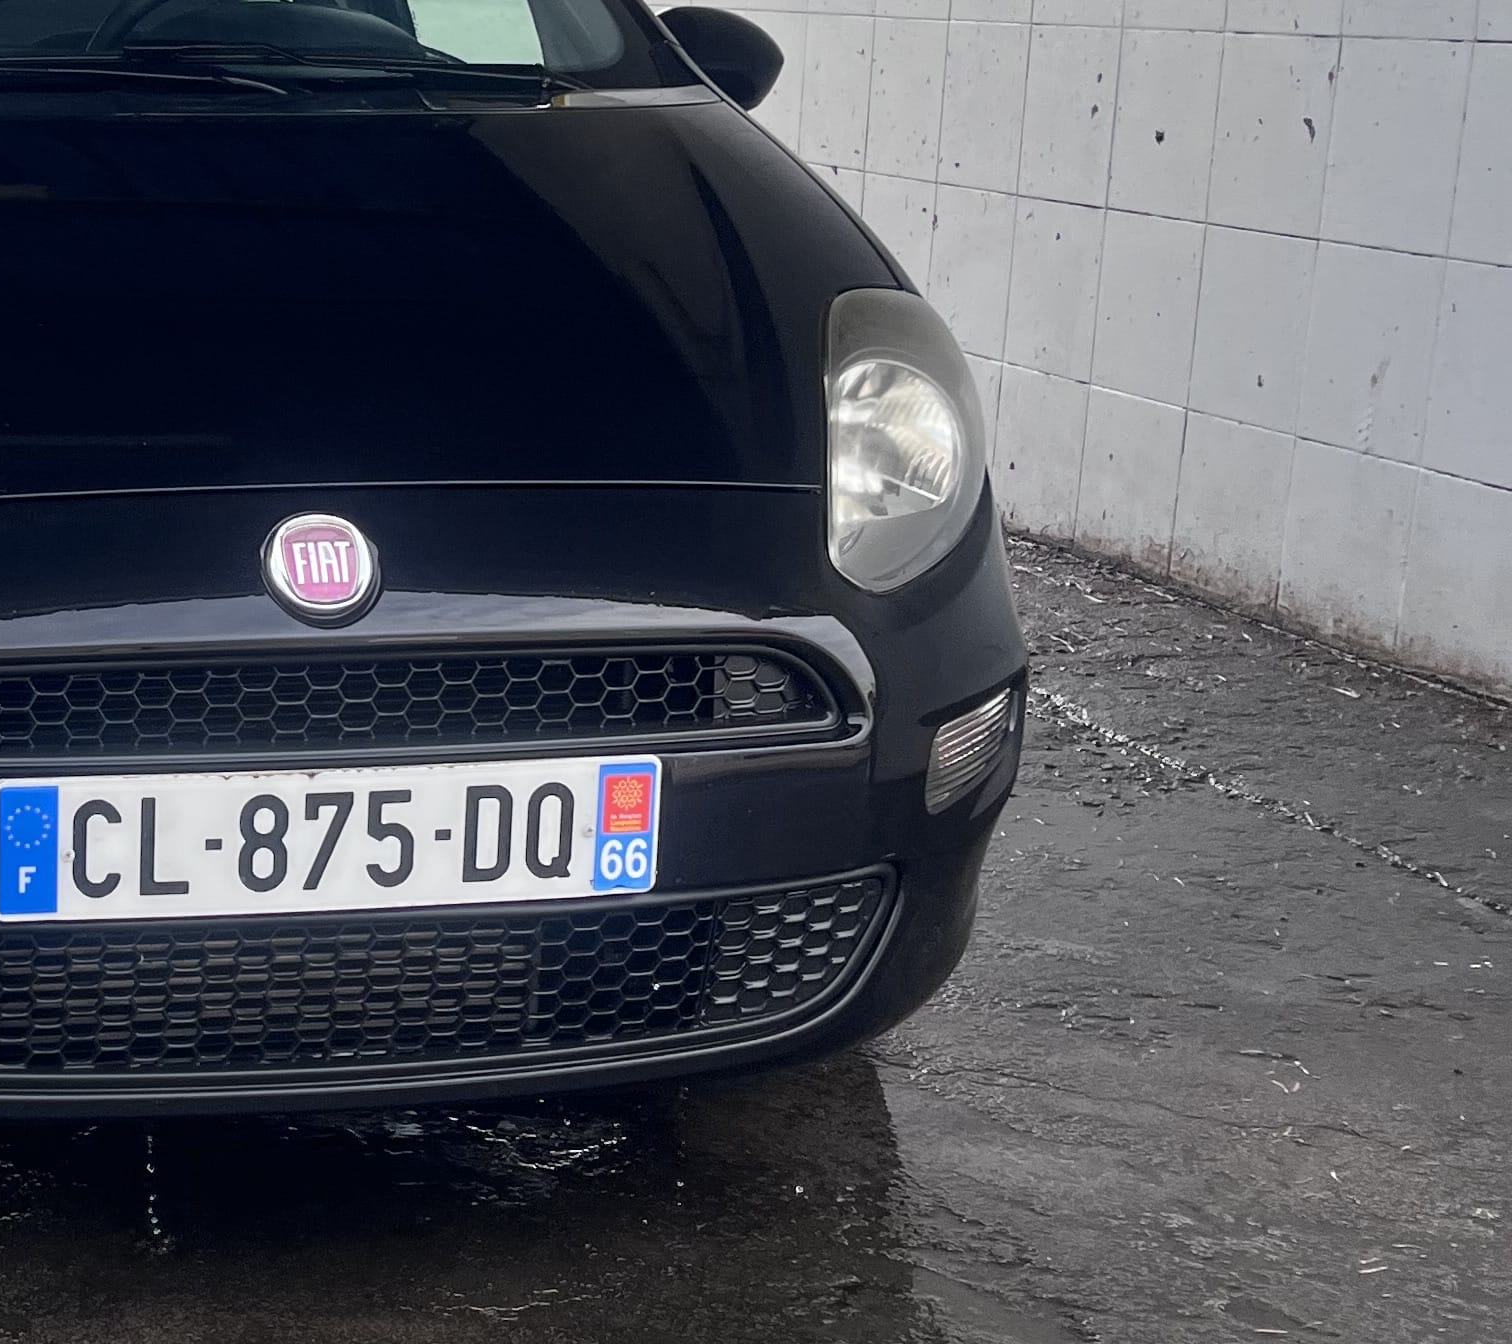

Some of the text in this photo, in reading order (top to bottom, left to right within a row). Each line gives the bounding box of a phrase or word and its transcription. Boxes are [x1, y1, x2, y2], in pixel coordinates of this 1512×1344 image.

[291, 539, 354, 585] FIAT
[72, 782, 576, 899] CL-875-DQ
[600, 838, 648, 881] 66
[18, 865, 37, 895] F
